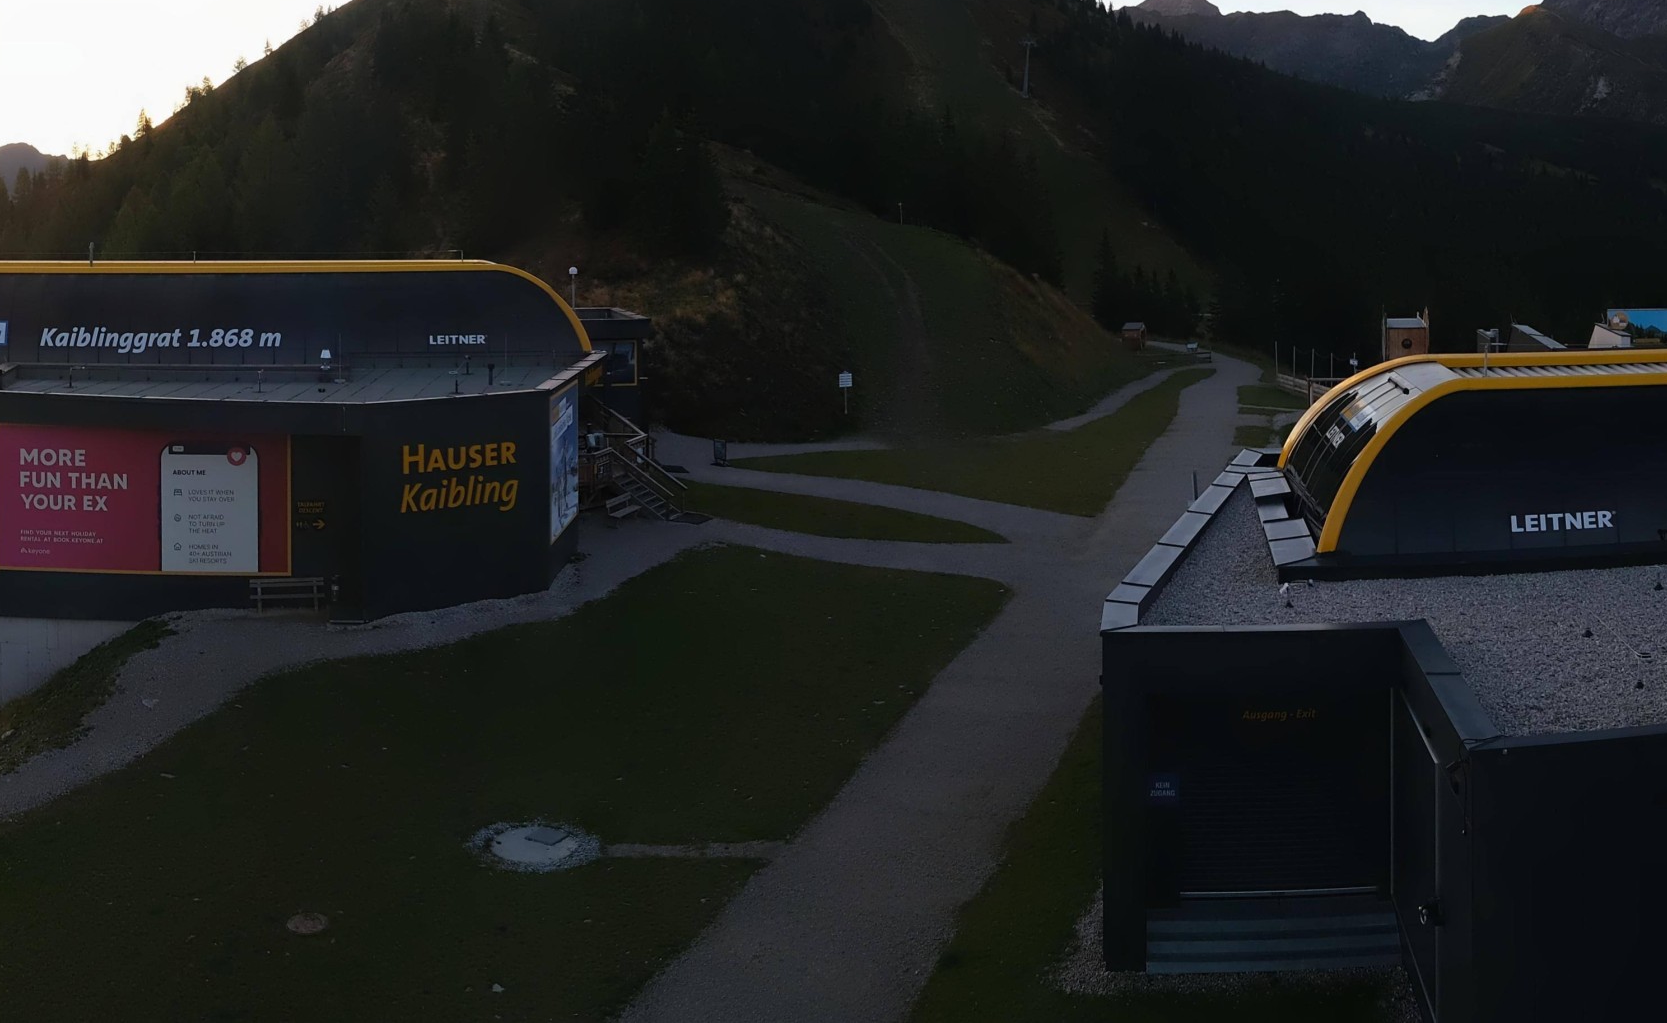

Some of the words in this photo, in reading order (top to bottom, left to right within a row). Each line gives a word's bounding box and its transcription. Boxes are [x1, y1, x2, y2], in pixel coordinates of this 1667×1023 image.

[40, 327, 182, 354] Kaiblinggrat
[187, 328, 255, 348] 1.868
[258, 333, 282, 348] m
[429, 334, 486, 345] LEITNER
[19, 448, 86, 466] MORE
[402, 441, 517, 475] HAUSER
[19, 471, 61, 489] FUN
[68, 473, 128, 490] THAN
[20, 494, 76, 511] YOUR
[83, 495, 108, 512] EX
[401, 475, 519, 514] Kaibling
[1510, 510, 1613, 533] LEITNER
[1242, 710, 1288, 722] Ausgang
[1296, 708, 1316, 719] Exit
